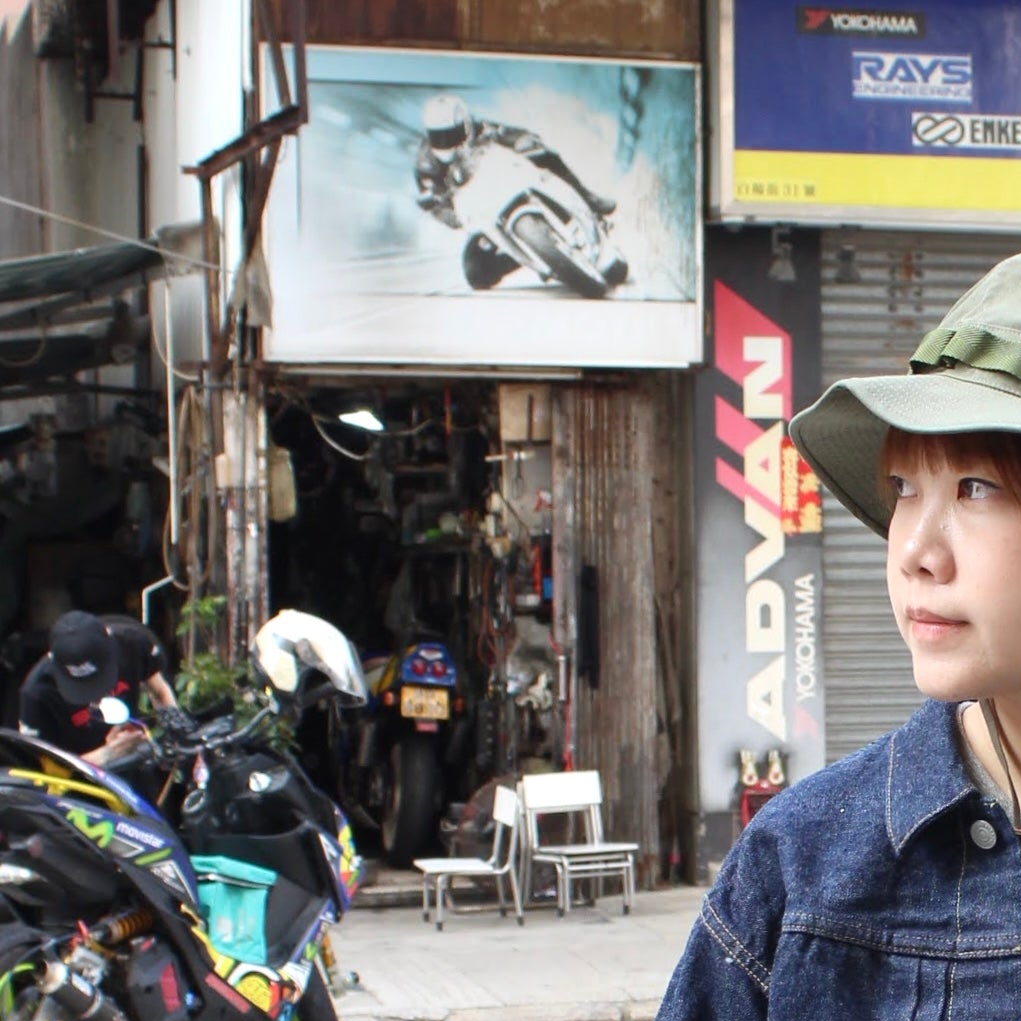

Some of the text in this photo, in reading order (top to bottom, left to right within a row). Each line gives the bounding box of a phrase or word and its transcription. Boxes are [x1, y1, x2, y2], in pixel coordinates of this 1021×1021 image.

[831, 14, 918, 34] YOKOHAMA
[853, 55, 970, 84] RAYS
[743, 336, 787, 742] ADVAN
[794, 572, 816, 702] YOKOHAMA
[115, 821, 166, 850] movistar
